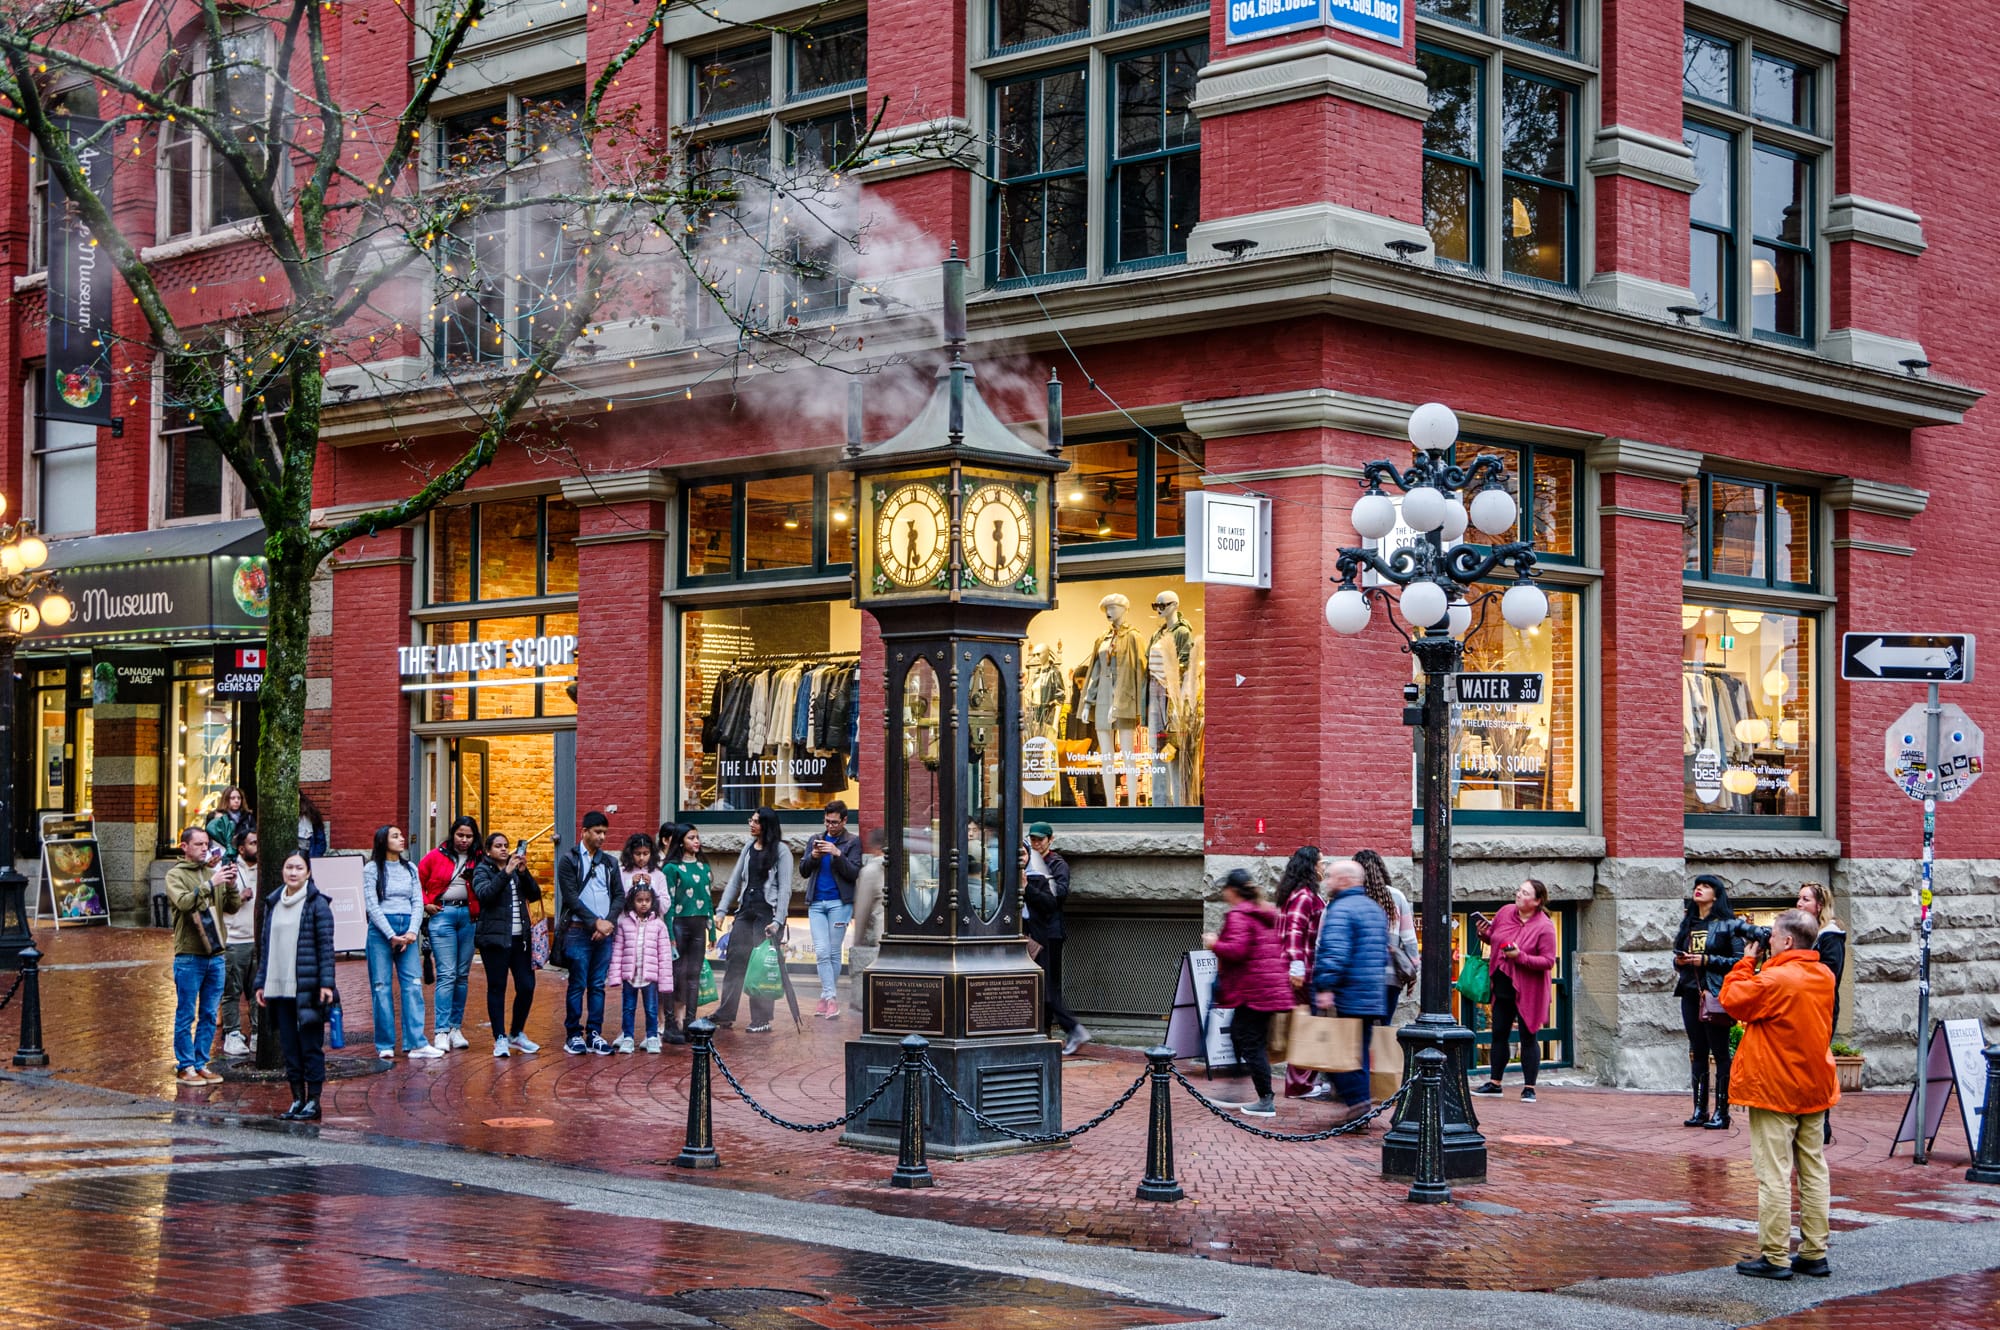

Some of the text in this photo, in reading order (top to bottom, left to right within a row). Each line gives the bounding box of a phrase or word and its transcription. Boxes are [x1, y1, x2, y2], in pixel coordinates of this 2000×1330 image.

[79, 242, 97, 334] Museum
[1217, 525, 1245, 537] THE LATEST
[1217, 538, 1246, 552] SCOOP
[83, 588, 173, 623] Museum
[398, 635, 577, 675] THE LATEST SCOOP
[117, 666, 165, 676] CANADIAN
[130, 675, 153, 684] JADE
[225, 673, 263, 683] CANADI
[217, 682, 244, 692] GEMS
[245, 682, 254, 692] &
[1461, 678, 1533, 699] WATER ST
[1519, 688, 1537, 699] 300
[1066, 751, 1091, 761] Voted
[1093, 751, 1112, 761] Best
[1125, 751, 1169, 761] Vancouver
[720, 758, 827, 777] THE LATEST SCOOP
[1465, 753, 1503, 772] LATEST
[1506, 755, 1541, 774] SCOOP
[1066, 765, 1166, 777] Women's Clothing Store
[1764, 765, 1793, 775] Vancouver
